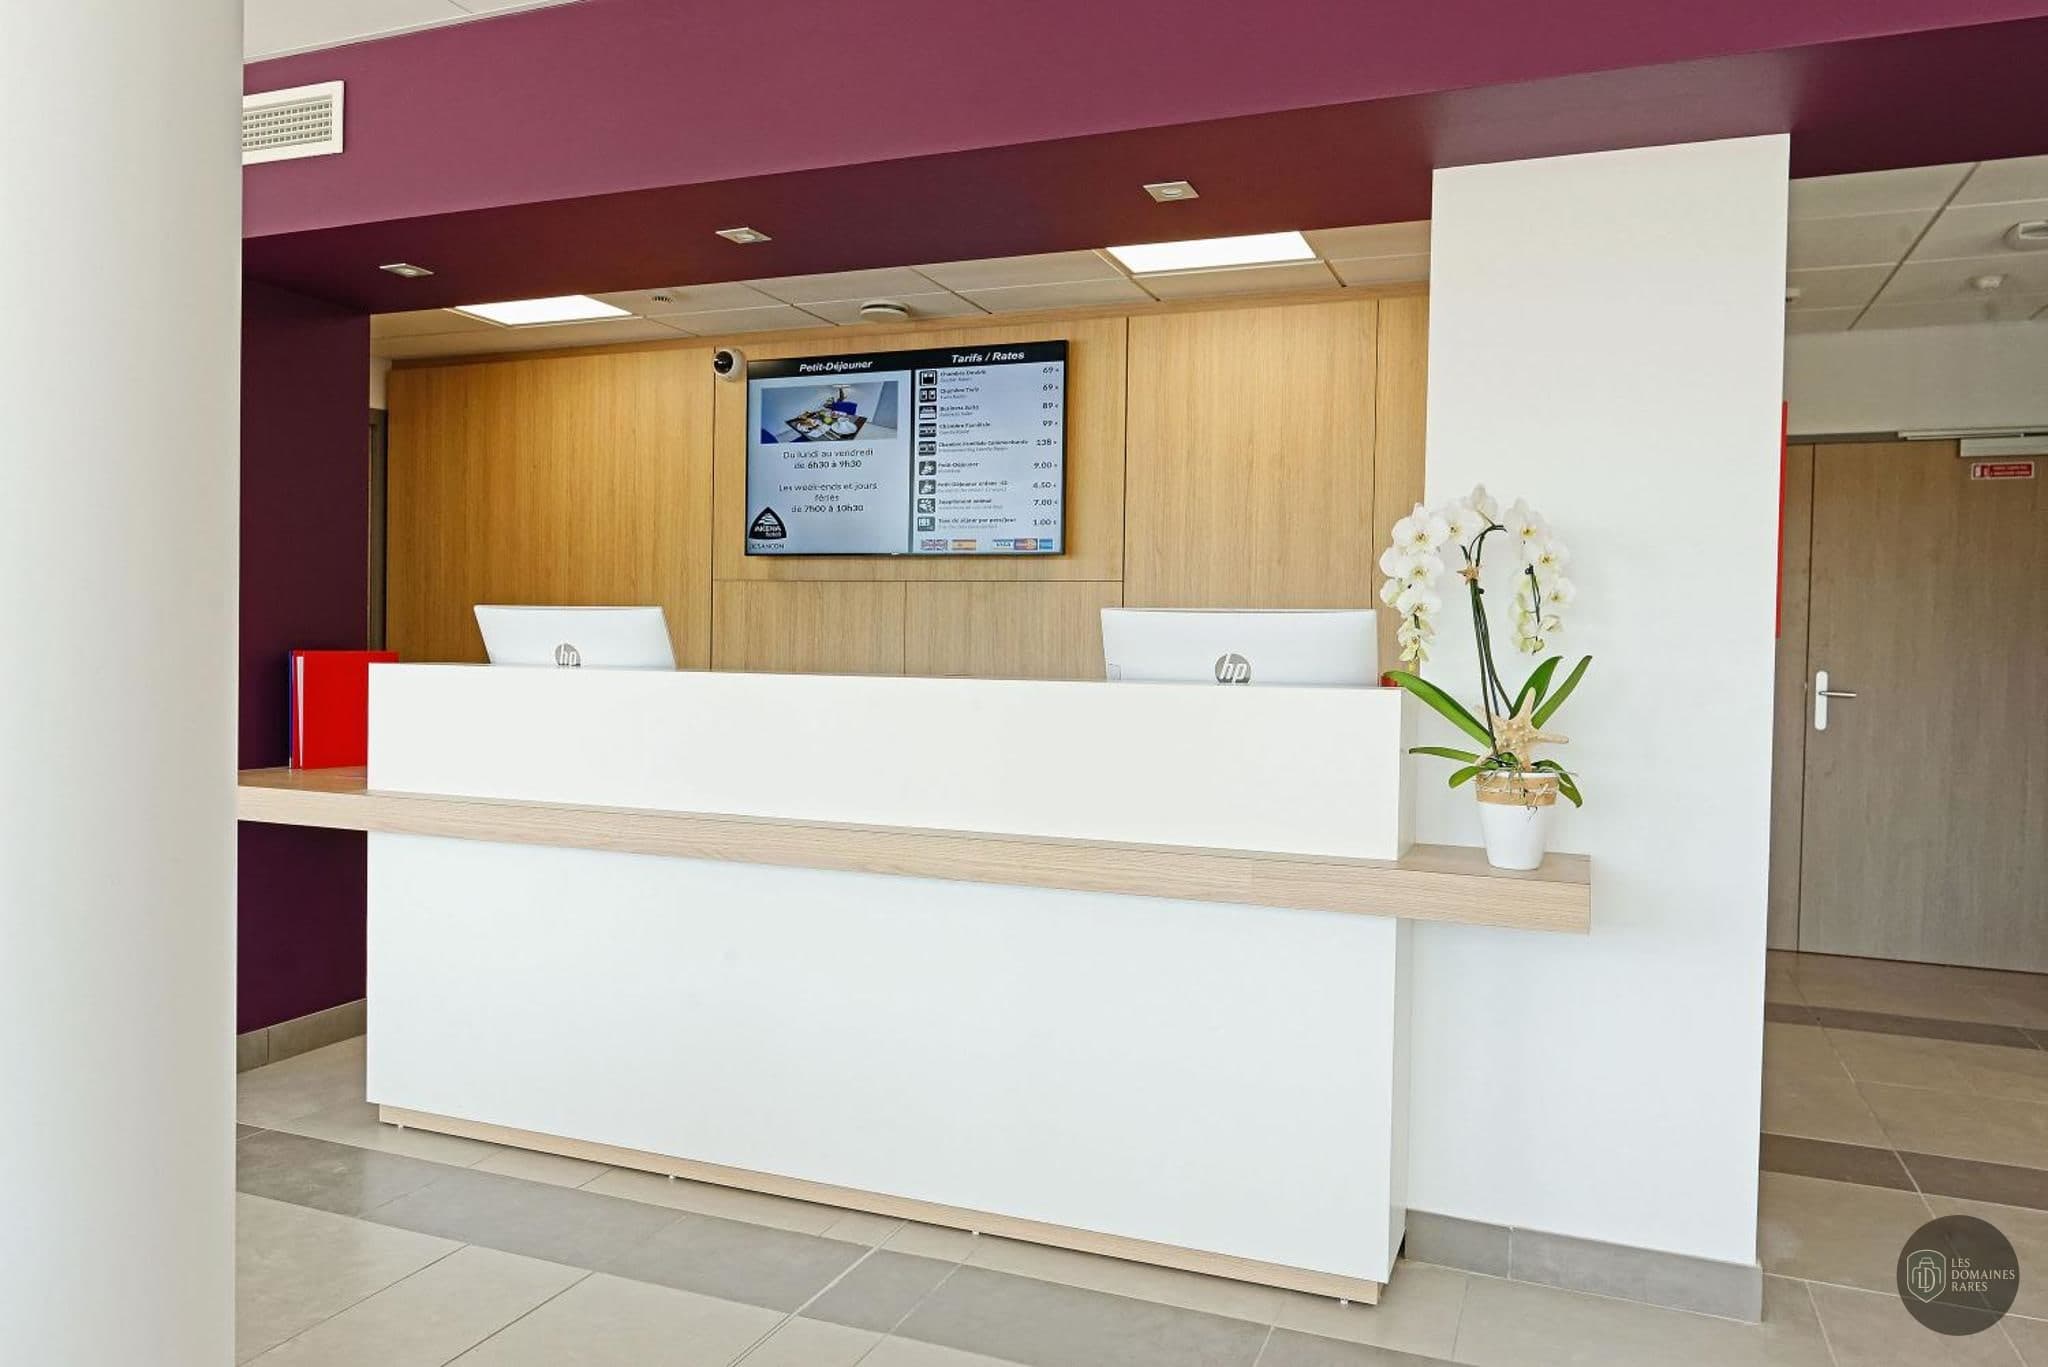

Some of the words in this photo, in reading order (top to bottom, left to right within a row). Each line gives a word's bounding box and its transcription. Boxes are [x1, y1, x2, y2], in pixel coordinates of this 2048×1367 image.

[952, 353, 982, 363] Tarifs
[985, 352, 992, 360] /
[992, 351, 1024, 360] Rates
[783, 450, 796, 459] Du
[835, 448, 873, 457] vendredi
[808, 460, 829, 469] 6h30
[832, 460, 837, 468] à
[839, 460, 862, 468] 9h30
[854, 482, 877, 493] jours
[804, 505, 826, 513] 7h00
[837, 504, 864, 512] 10h30
[556, 642, 582, 667] hp
[1218, 652, 1249, 683] hp
